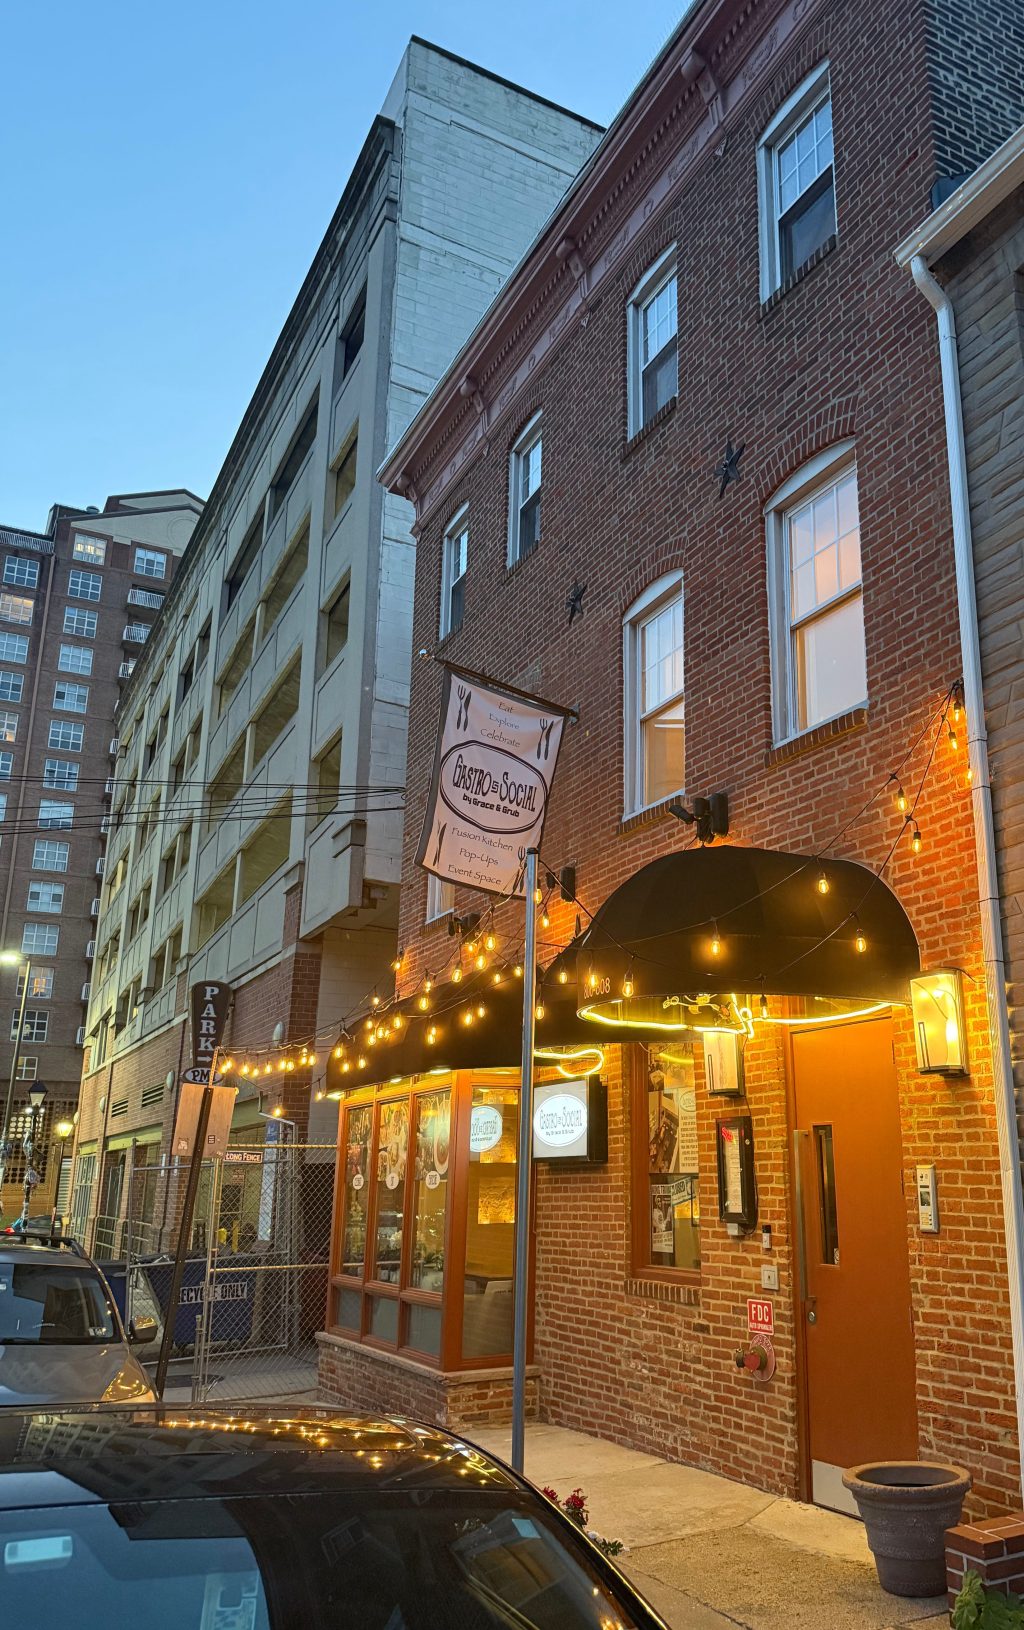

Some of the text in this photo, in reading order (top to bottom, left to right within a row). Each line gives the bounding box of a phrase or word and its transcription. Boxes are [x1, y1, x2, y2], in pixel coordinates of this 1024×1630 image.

[498, 701, 515, 714] Eat
[489, 712, 520, 730] Explore
[480, 728, 521, 748] Celebrate
[462, 793, 520, 818] by Grace & Grub
[451, 827, 514, 852] Fusion Kitchen
[459, 847, 499, 868] Pop-Ups
[447, 864, 502, 885] Event Space
[198, 986, 219, 1051] PARK
[191, 1069, 216, 1082] PM
[225, 1152, 261, 1162] LONG FENCE
[220, 1283, 246, 1299] ONLY
[751, 1303, 769, 1323] FDC
